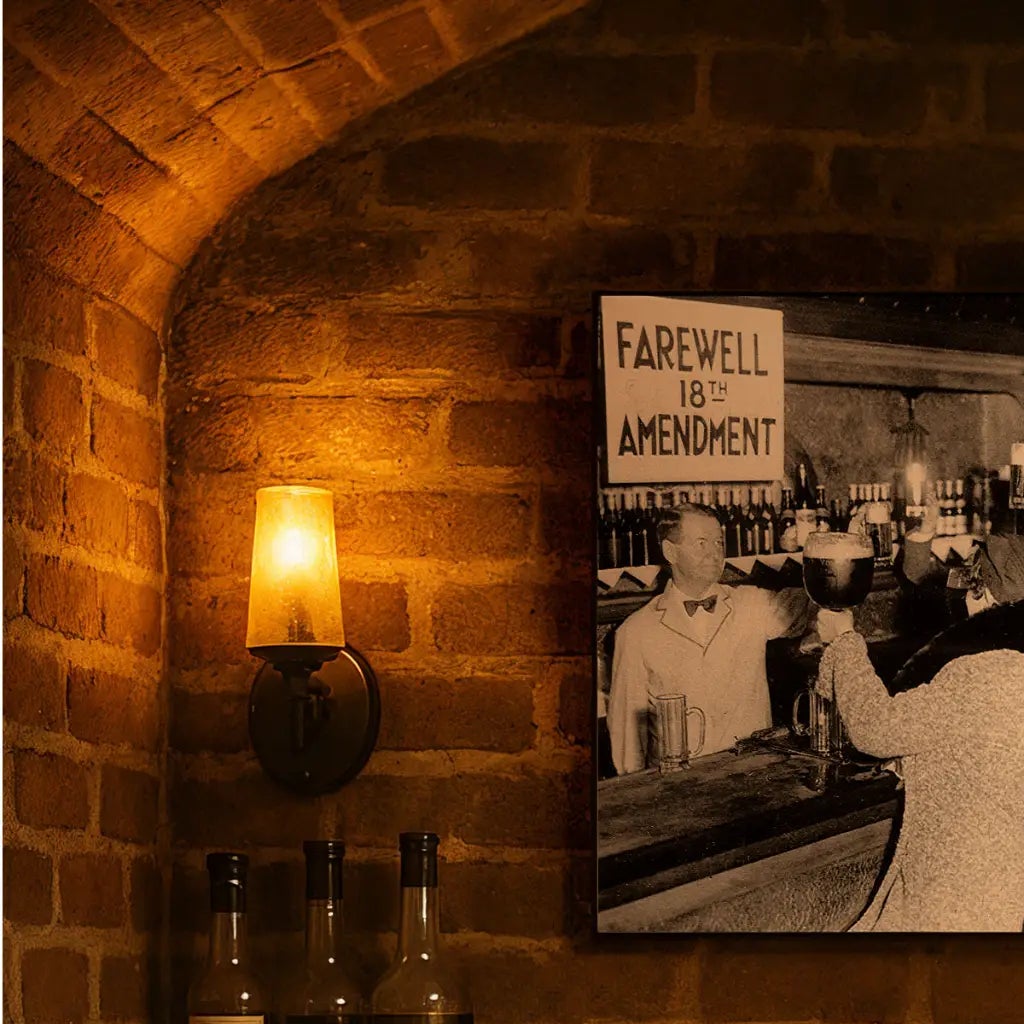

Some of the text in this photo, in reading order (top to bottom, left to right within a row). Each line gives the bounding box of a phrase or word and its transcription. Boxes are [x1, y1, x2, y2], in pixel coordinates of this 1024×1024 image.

[616, 320, 768, 377] FAREWELL
[680, 379, 728, 409] 18TH
[618, 413, 776, 456] AMENDMENT
